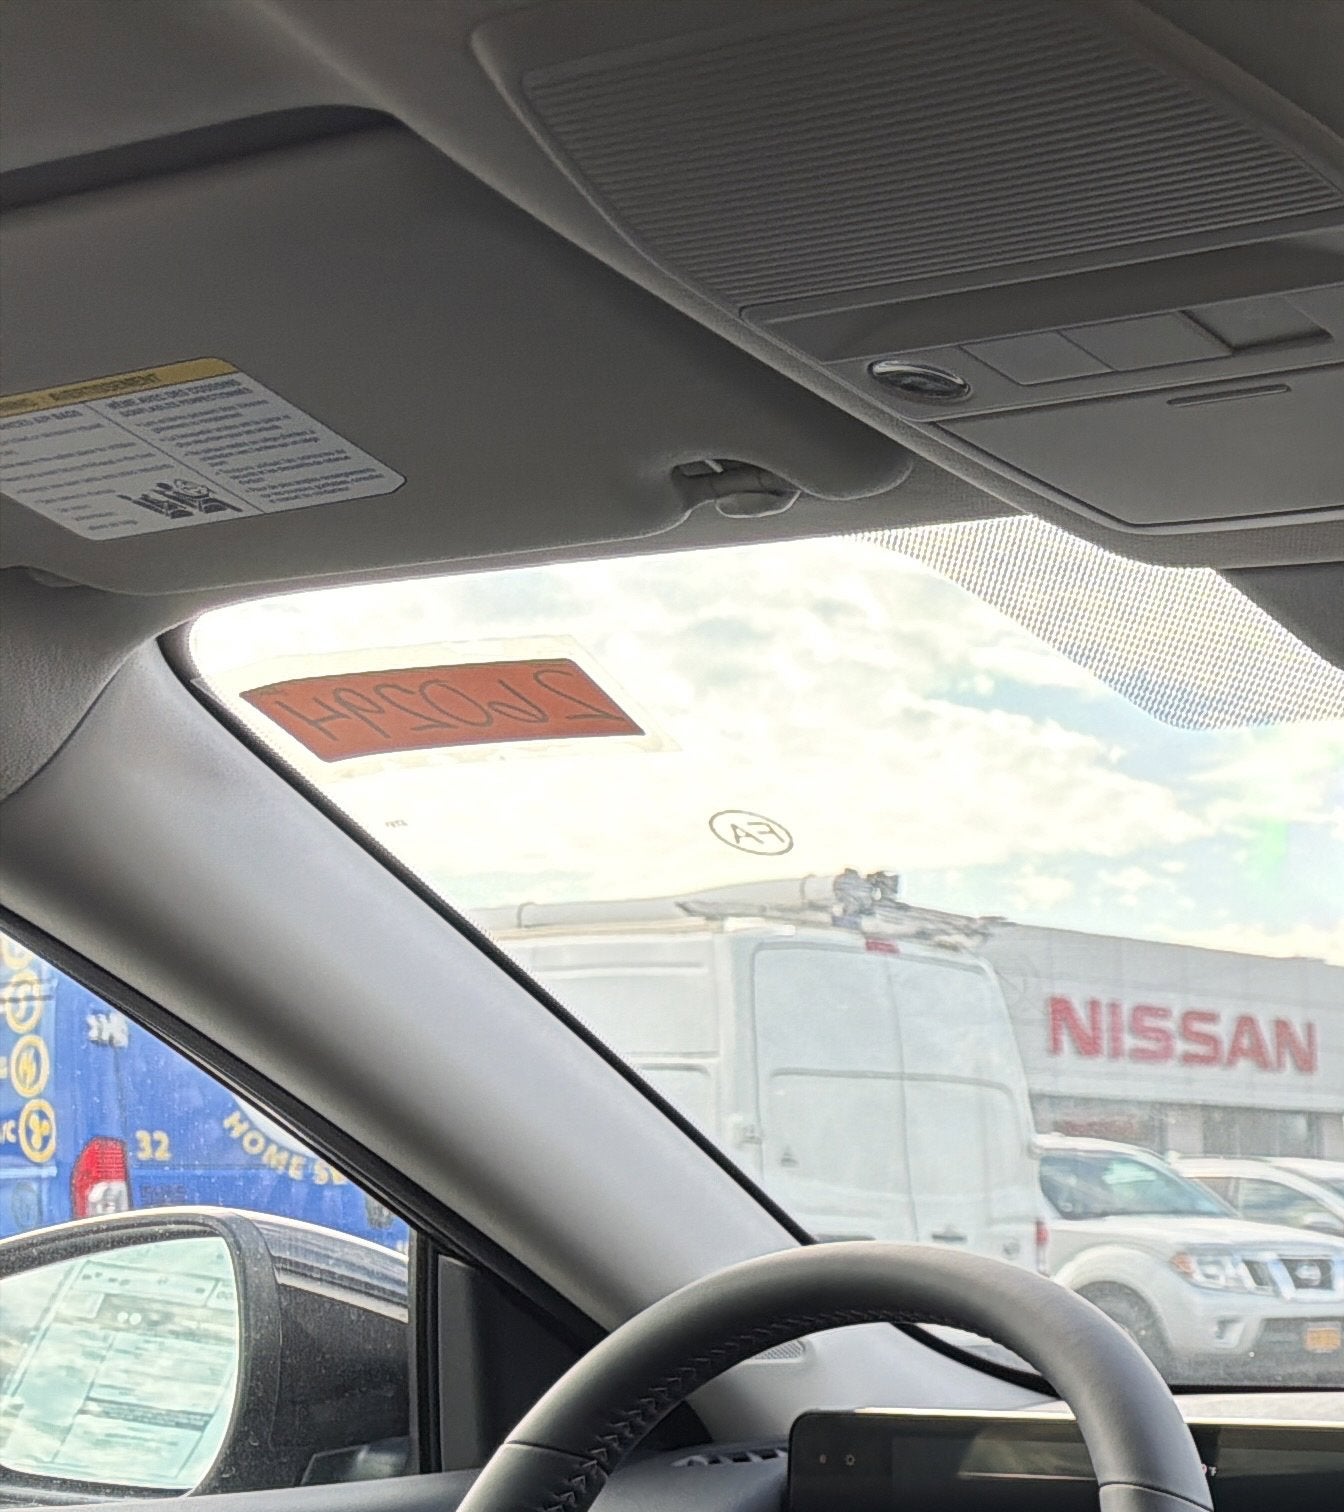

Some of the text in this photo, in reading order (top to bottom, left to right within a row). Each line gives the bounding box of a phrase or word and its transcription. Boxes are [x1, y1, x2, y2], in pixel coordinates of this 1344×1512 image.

[1047, 994, 1319, 1074] NISSAN
[135, 1130, 171, 1161] 32
[223, 1110, 303, 1180] HOME
